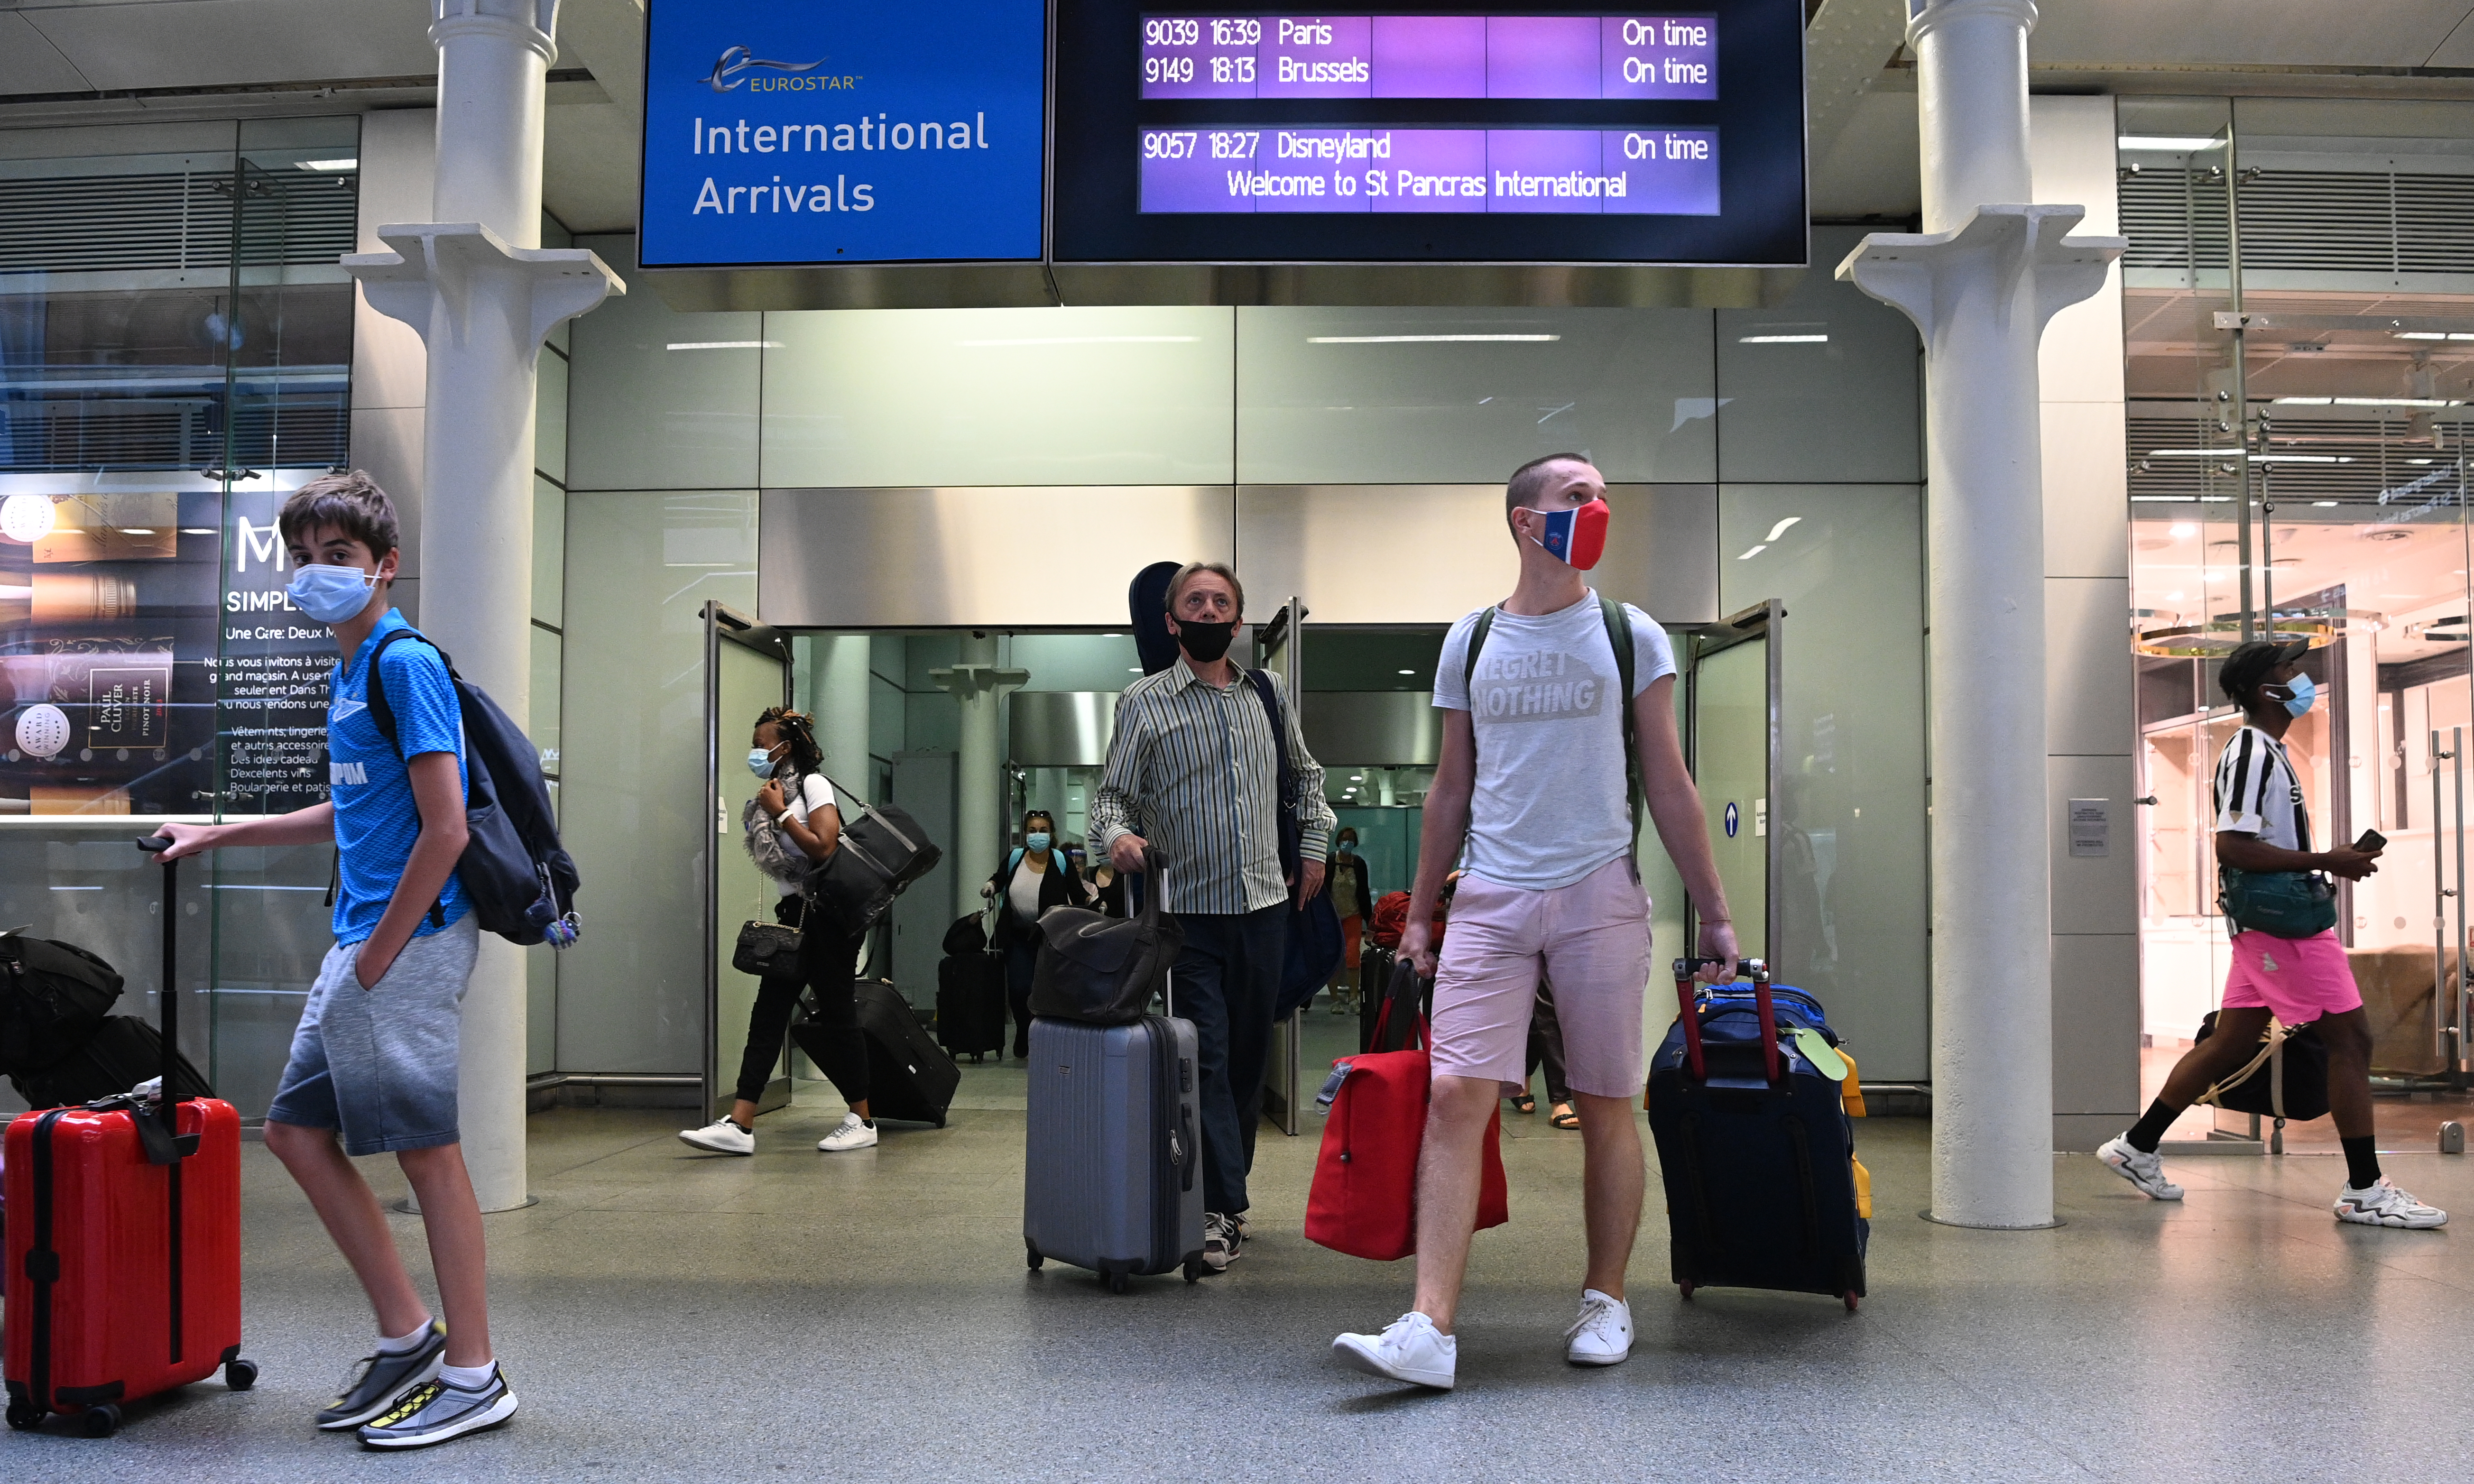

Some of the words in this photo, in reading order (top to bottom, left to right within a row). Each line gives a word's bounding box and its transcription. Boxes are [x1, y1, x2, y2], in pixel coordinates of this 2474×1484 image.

[1145, 19, 1199, 46] 9039
[1209, 19, 1261, 46] 16:39
[1279, 19, 1332, 45] Paris
[1623, 19, 1655, 46] On
[1663, 20, 1707, 46] time
[1145, 57, 1194, 83] 9149
[1209, 57, 1255, 83] 18:13
[1278, 56, 1369, 83] Brussels
[1623, 57, 1655, 83] On
[1663, 57, 1708, 84] time
[694, 112, 989, 154] International
[1144, 132, 1198, 159] 9057
[1208, 132, 1260, 159] 18:27
[1277, 132, 1391, 165] Disneyland
[1623, 133, 1656, 160] On
[1664, 133, 1708, 160] time
[692, 175, 875, 215] Arrivals
[1227, 170, 1326, 197] Welcome
[1333, 170, 1357, 196] to
[1365, 170, 1390, 196] St
[1397, 170, 1487, 197] Pancras
[1495, 170, 1627, 197] International
[226, 591, 302, 611] SIMPL
[226, 627, 252, 639] Une
[288, 627, 322, 639] Deux
[237, 657, 262, 667] vous
[265, 656, 303, 667] invitons
[305, 655, 312, 667] à
[245, 670, 288, 683] magasin.
[291, 670, 300, 681] A
[302, 672, 321, 681] use
[289, 684, 317, 695] Dans
[1471, 679, 1595, 717] NOTHING
[100, 691, 112, 723] PAUL
[111, 683, 123, 733] CLUVER
[235, 701, 261, 710] nous
[309, 701, 330, 710] une
[142, 707, 150, 737] PINOT
[231, 725, 286, 737] Vêtemnts,
[231, 740, 242, 750] et
[244, 740, 274, 750] autrs
[290, 768, 312, 778] vins
[292, 782, 303, 793] et
